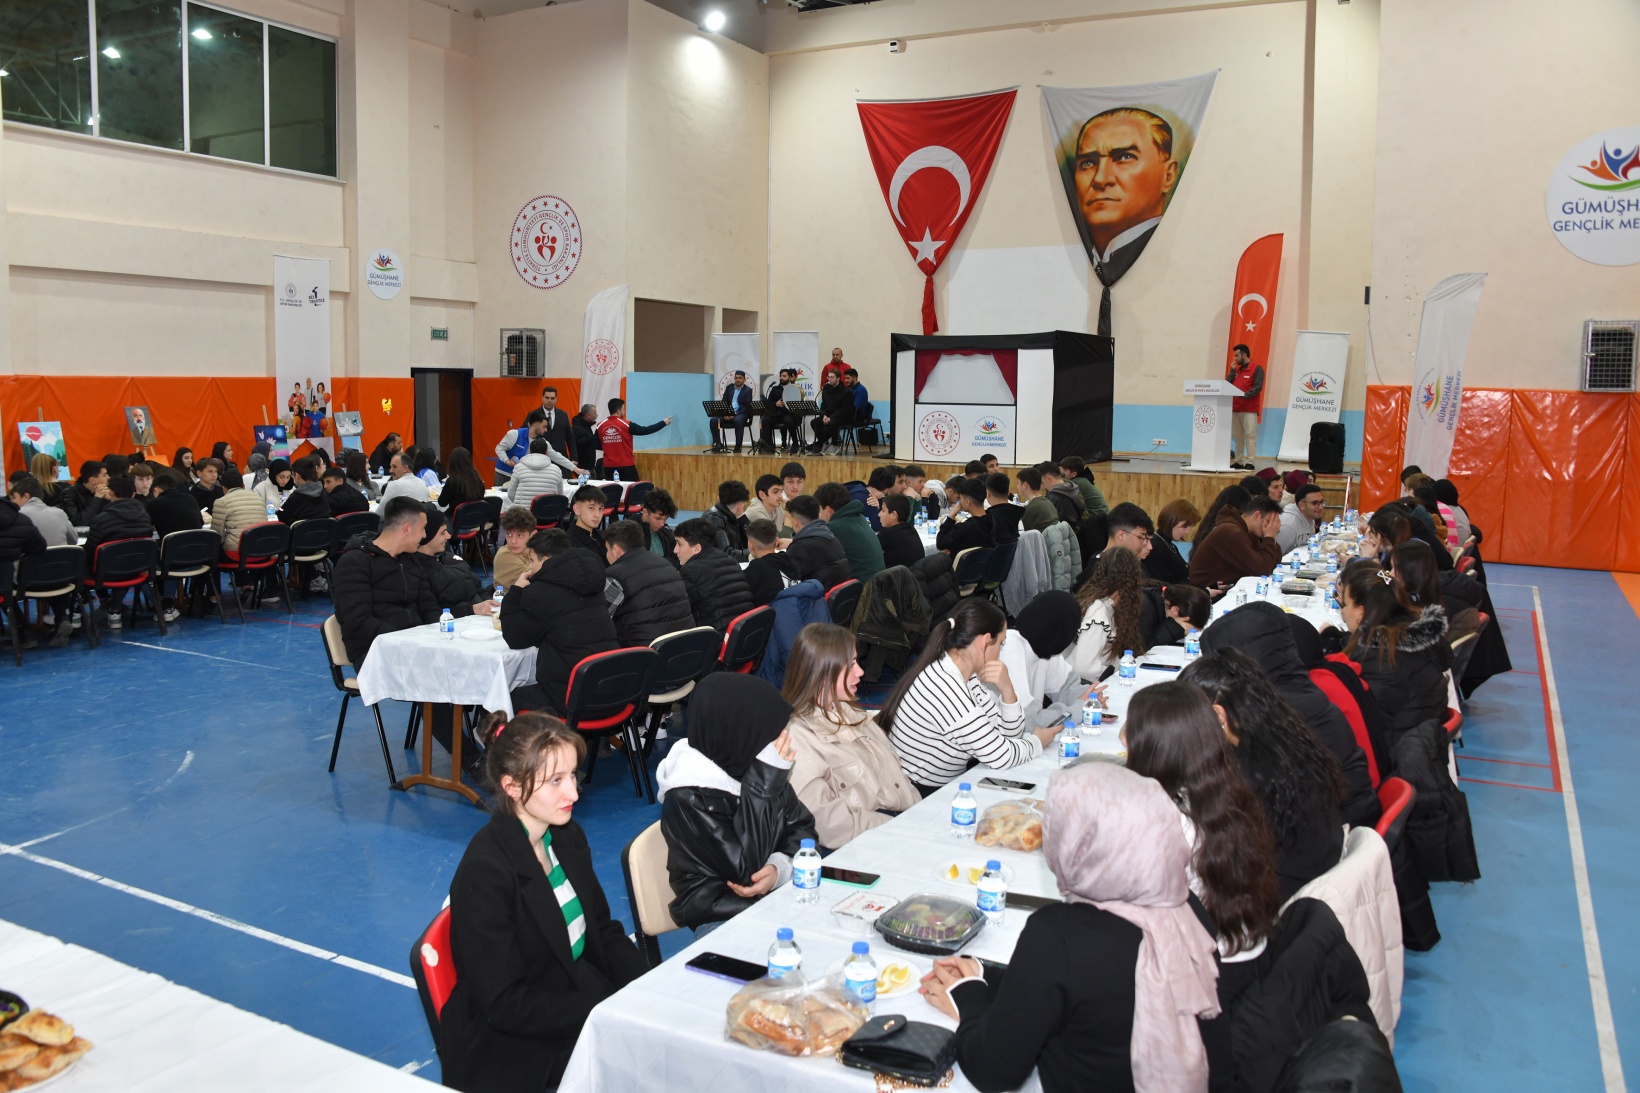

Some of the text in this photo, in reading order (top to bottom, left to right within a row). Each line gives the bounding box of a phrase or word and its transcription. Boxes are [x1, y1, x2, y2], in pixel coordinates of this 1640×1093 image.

[1562, 196, 1640, 216] GÜMÜŞH
[1553, 216, 1615, 233] GENÇLİK
[369, 272, 399, 281] GÜMÜŞHANE
[1295, 395, 1335, 406] GÜMÜŞHANE
[1437, 375, 1454, 423] GÜMÜŞHANE
[1291, 403, 1313, 411] GENÇLİK
